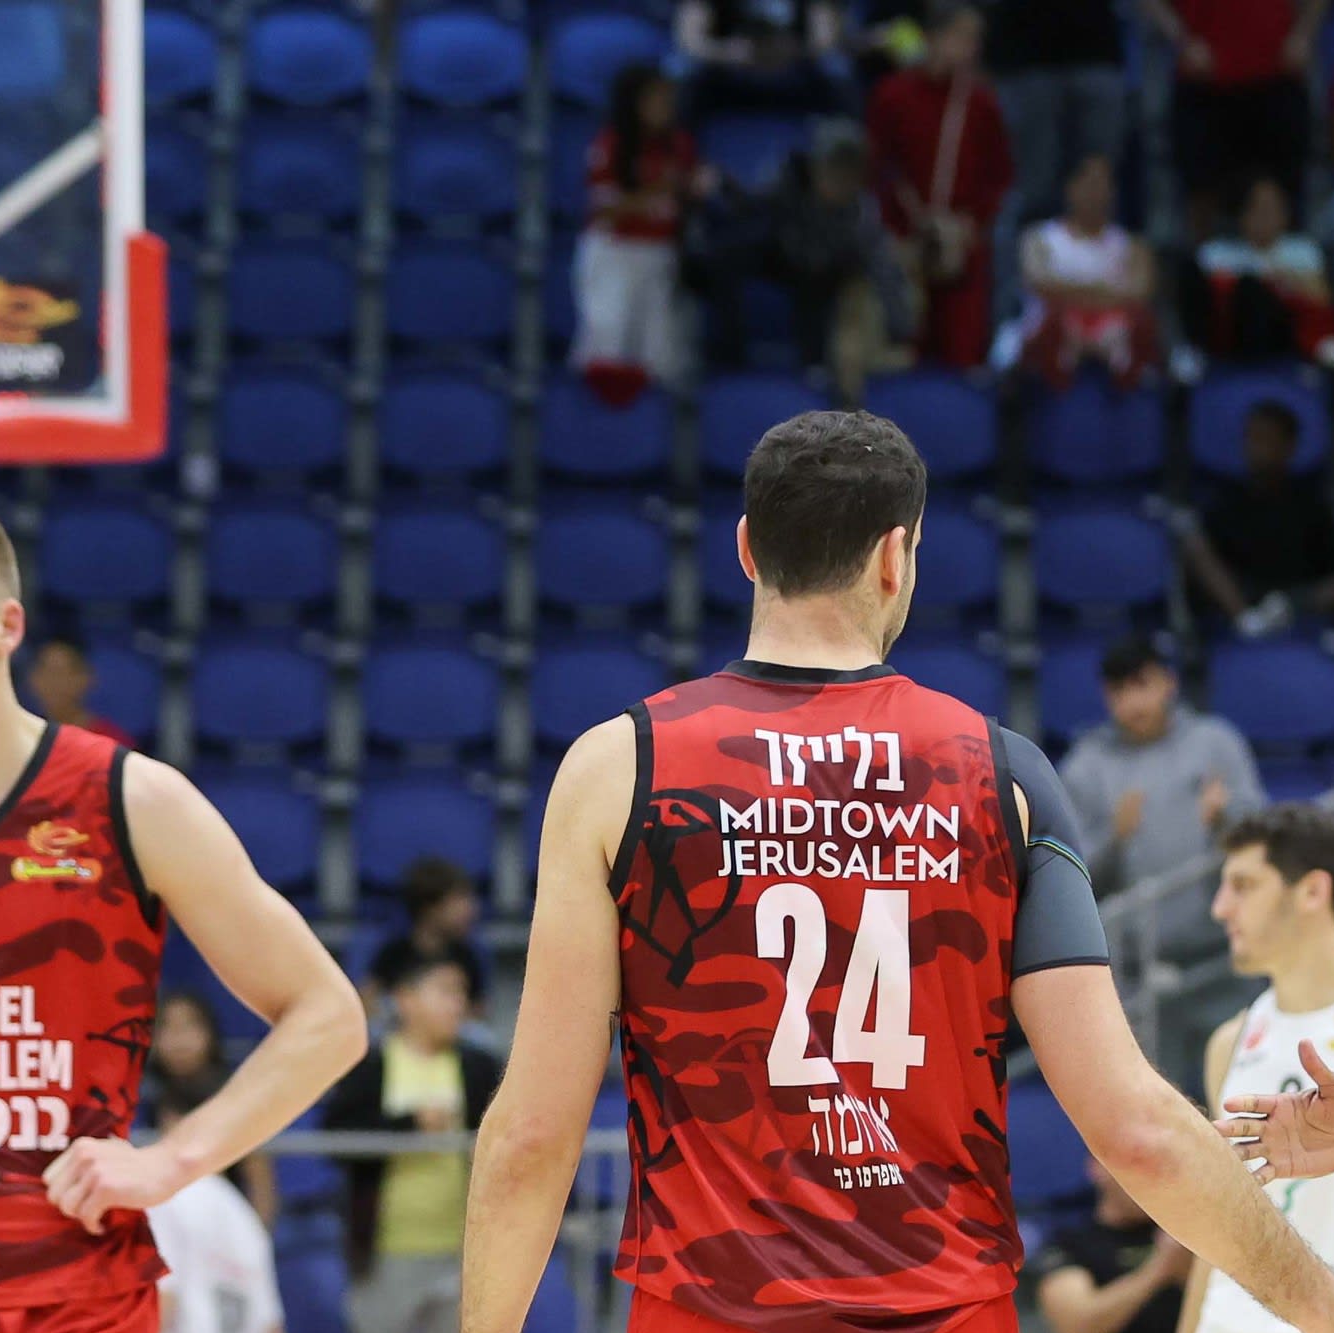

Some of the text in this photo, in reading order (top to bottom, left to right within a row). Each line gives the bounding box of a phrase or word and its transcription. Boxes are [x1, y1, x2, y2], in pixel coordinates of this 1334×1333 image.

[754, 725, 905, 792] בלייזר
[719, 797, 960, 841] MIDTOWN
[717, 839, 960, 884] JERUSALEM
[755, 883, 926, 1090] 24
